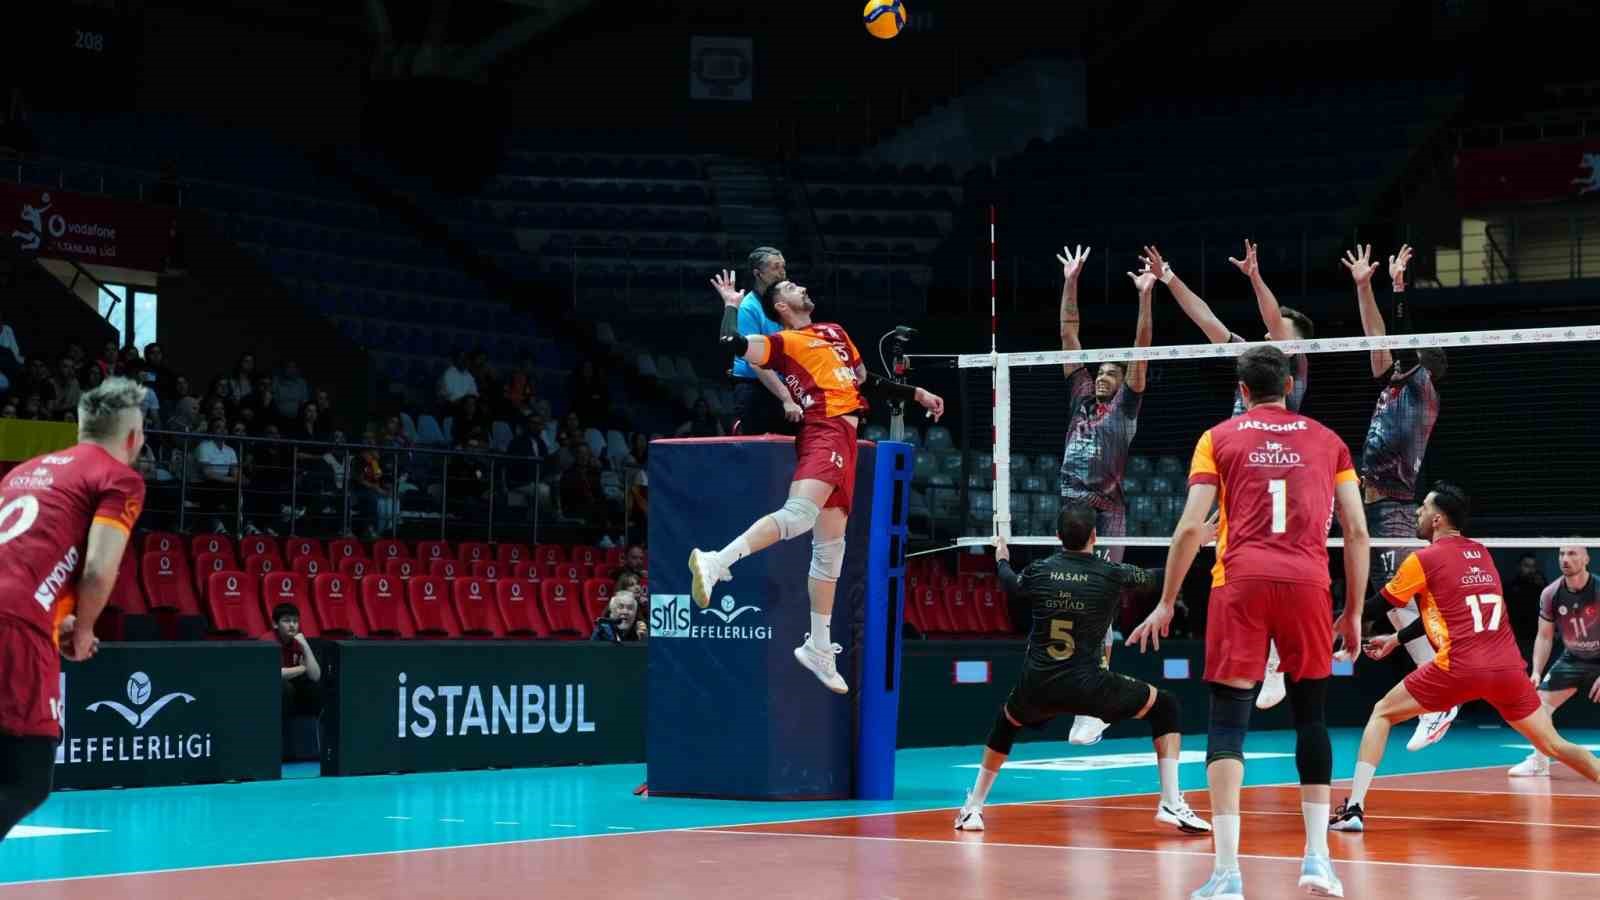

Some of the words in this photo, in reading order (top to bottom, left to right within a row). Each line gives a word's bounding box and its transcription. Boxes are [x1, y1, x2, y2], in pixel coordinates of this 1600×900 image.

[68, 223, 116, 240] vodafone
[1237, 420, 1308, 432] JAESCHKE
[830, 451, 844, 468] 13
[0, 494, 40, 545] 0
[1268, 479, 1286, 534] 1
[1380, 550, 1396, 572] 17
[1463, 550, 1482, 559] ULU
[1050, 571, 1088, 582] HASAN
[651, 597, 690, 631] SMS
[1465, 593, 1503, 633] 17
[1047, 619, 1075, 661] 5
[398, 672, 596, 738] İSTANBUL
